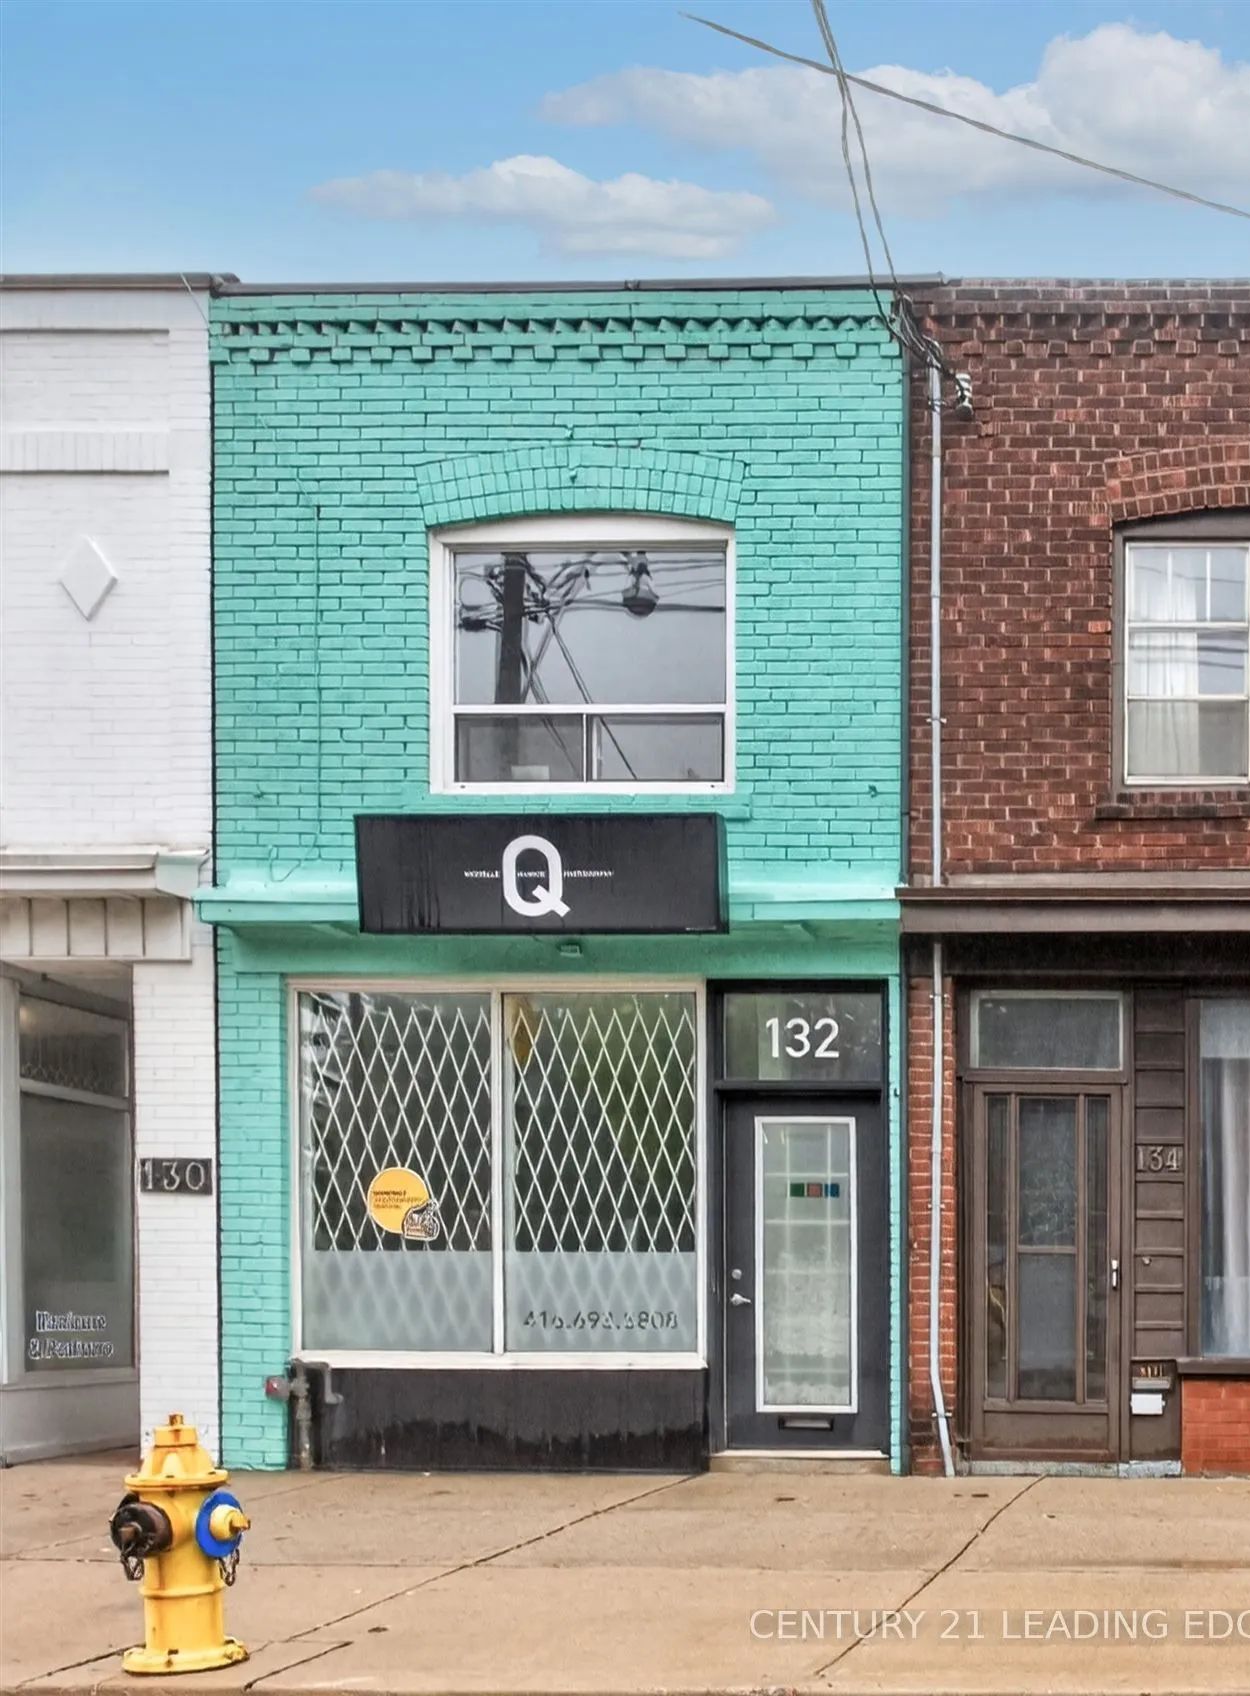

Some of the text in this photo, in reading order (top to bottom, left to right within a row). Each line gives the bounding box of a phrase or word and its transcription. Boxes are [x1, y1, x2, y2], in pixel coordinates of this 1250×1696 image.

[502, 834, 571, 917] Q
[765, 1017, 840, 1058] 132
[143, 1160, 206, 1191] 130
[1135, 1146, 1182, 1172] 134
